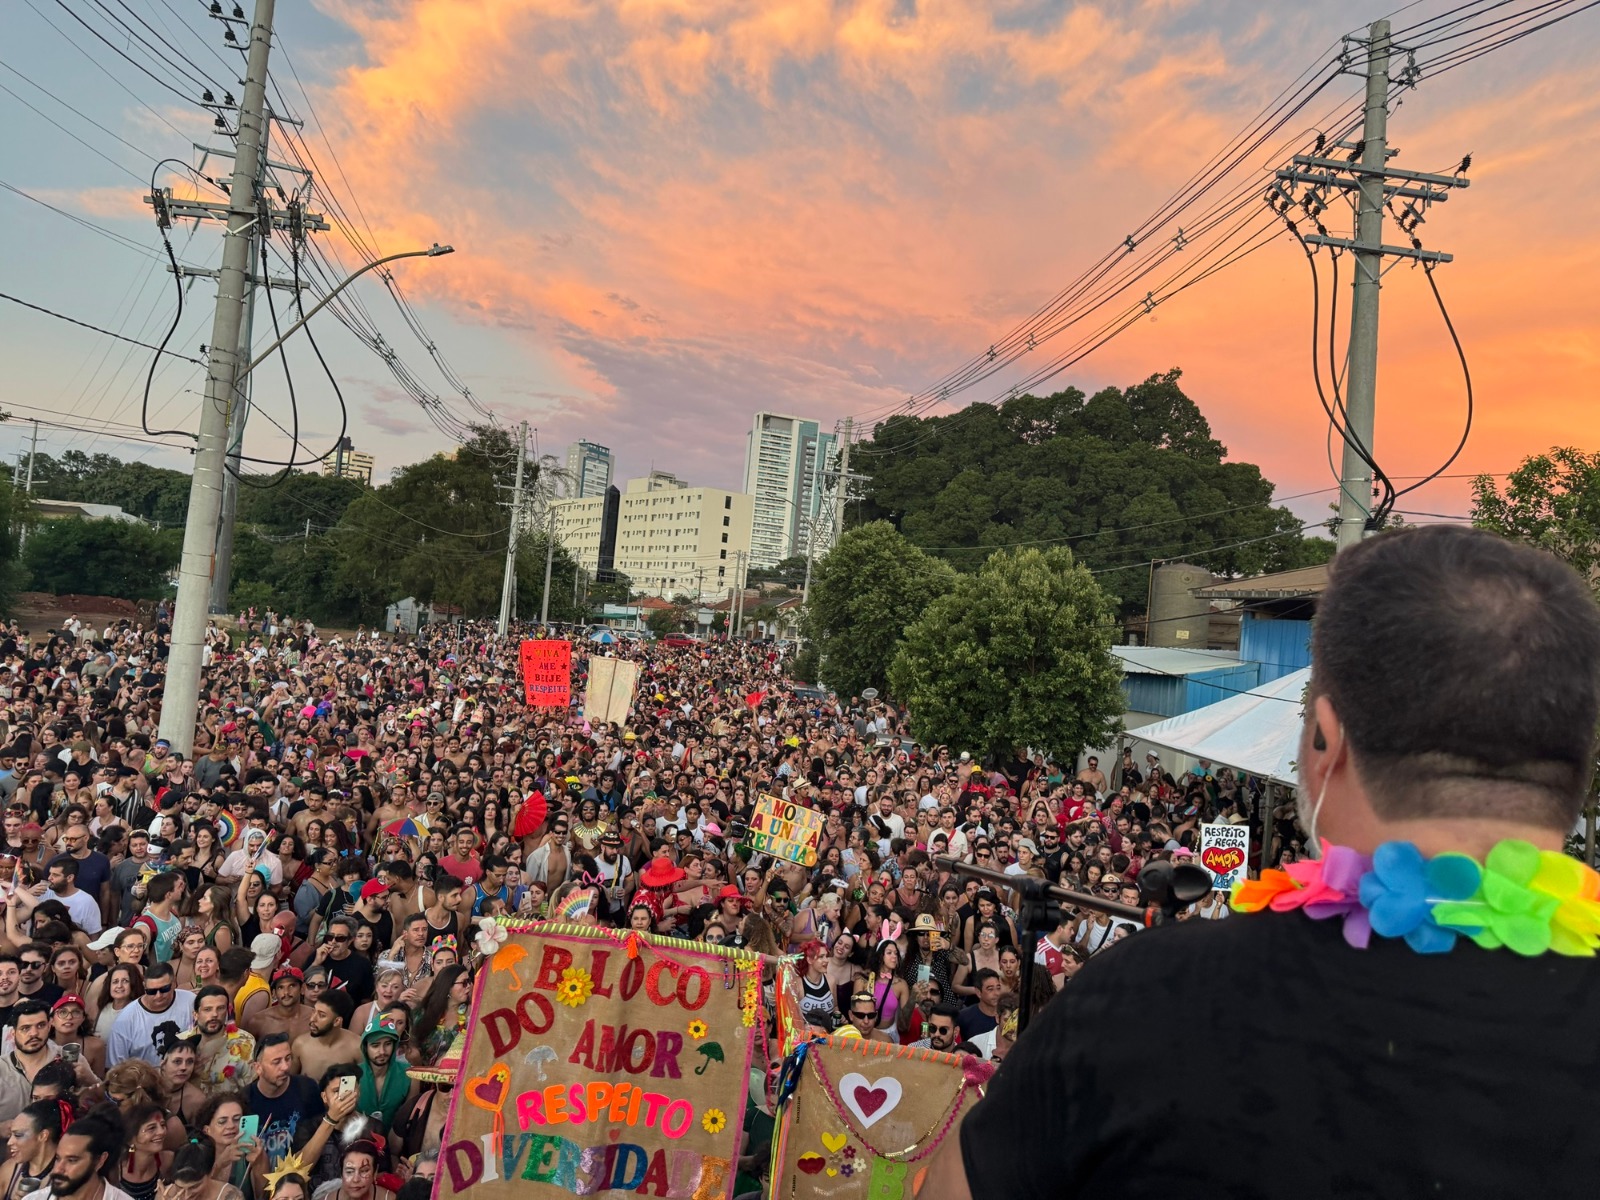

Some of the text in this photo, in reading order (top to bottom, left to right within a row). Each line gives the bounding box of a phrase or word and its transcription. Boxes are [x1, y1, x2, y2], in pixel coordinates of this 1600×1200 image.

[535, 649, 559, 658] VIVA
[539, 662, 556, 671] AME
[535, 673, 562, 683] BEIJE
[529, 684, 568, 694] RESPEITE
[760, 798, 807, 826] AMOR
[750, 812, 764, 831] A
[1204, 827, 1246, 838] RESPEITO
[1214, 838, 1246, 848] REGRA
[1206, 850, 1240, 868] AMOR
[533, 944, 712, 1011] BLOCO
[480, 991, 555, 1059] DO
[568, 1018, 684, 1079] AMOR
[516, 1081, 694, 1139] RESPEITO
[445, 1132, 732, 1200] DIVERSIDADE
